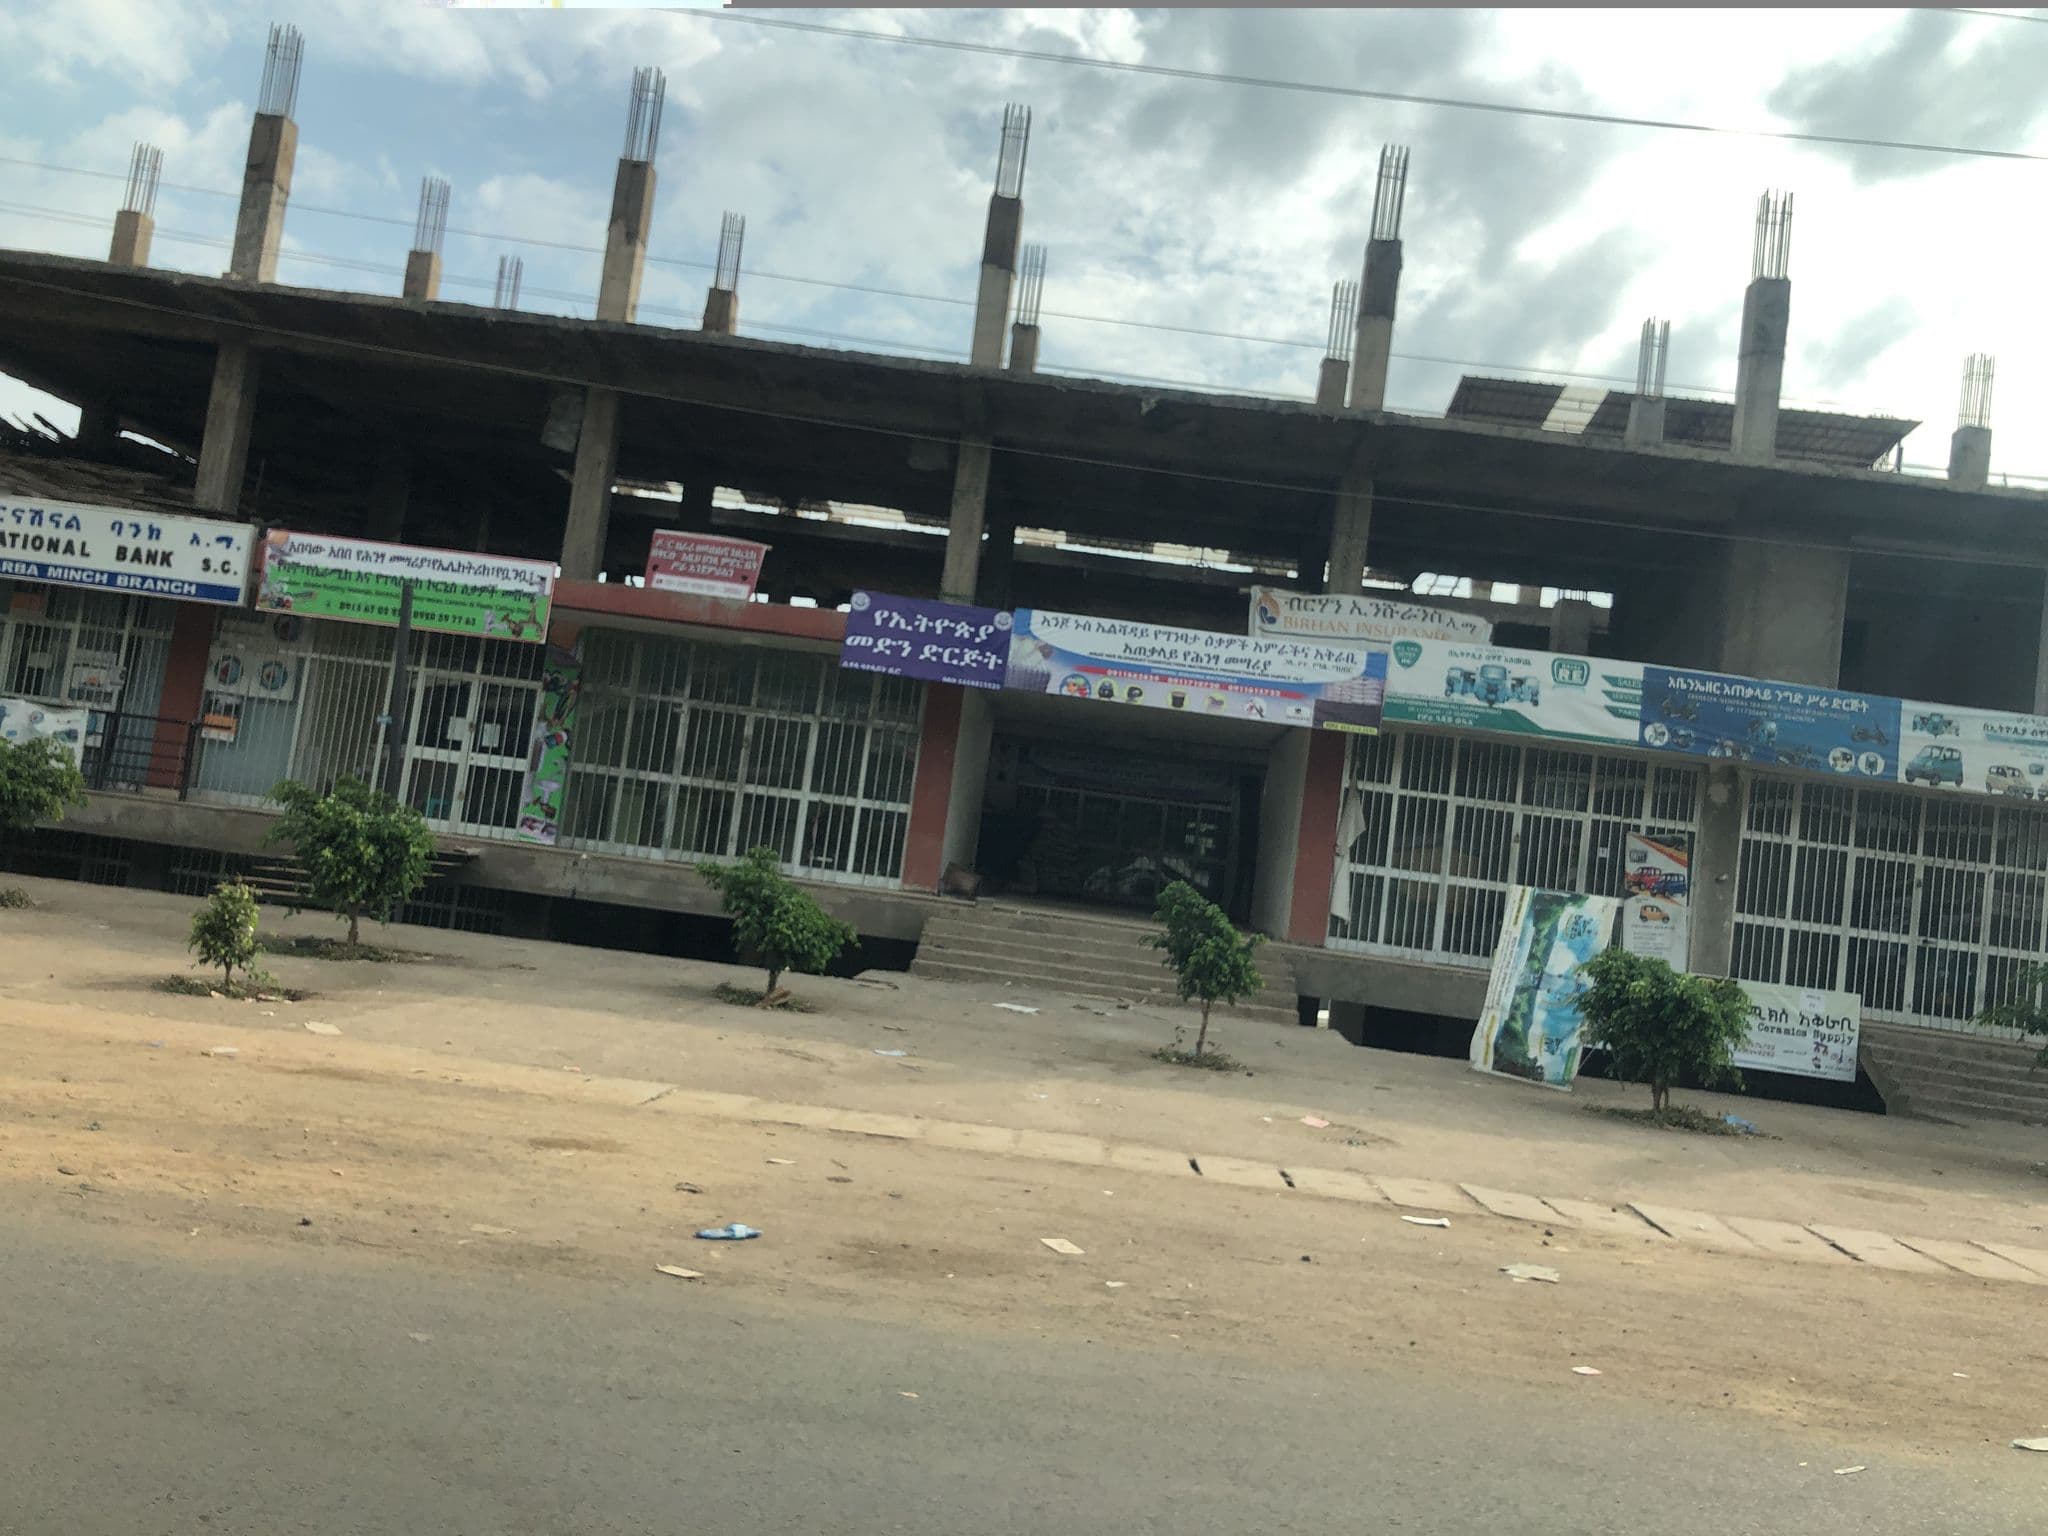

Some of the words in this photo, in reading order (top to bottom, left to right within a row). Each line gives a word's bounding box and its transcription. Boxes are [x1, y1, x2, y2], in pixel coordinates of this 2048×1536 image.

[110, 519, 163, 541] ባንክ
[115, 545, 174, 568] BANK
[201, 557, 239, 576] S.C.
[46, 563, 109, 585] MINCH
[116, 573, 198, 596] BRANCH
[872, 608, 995, 643] የኢትዮጵያ
[845, 635, 912, 658] መድን
[918, 643, 1004, 671] ድርጅት
